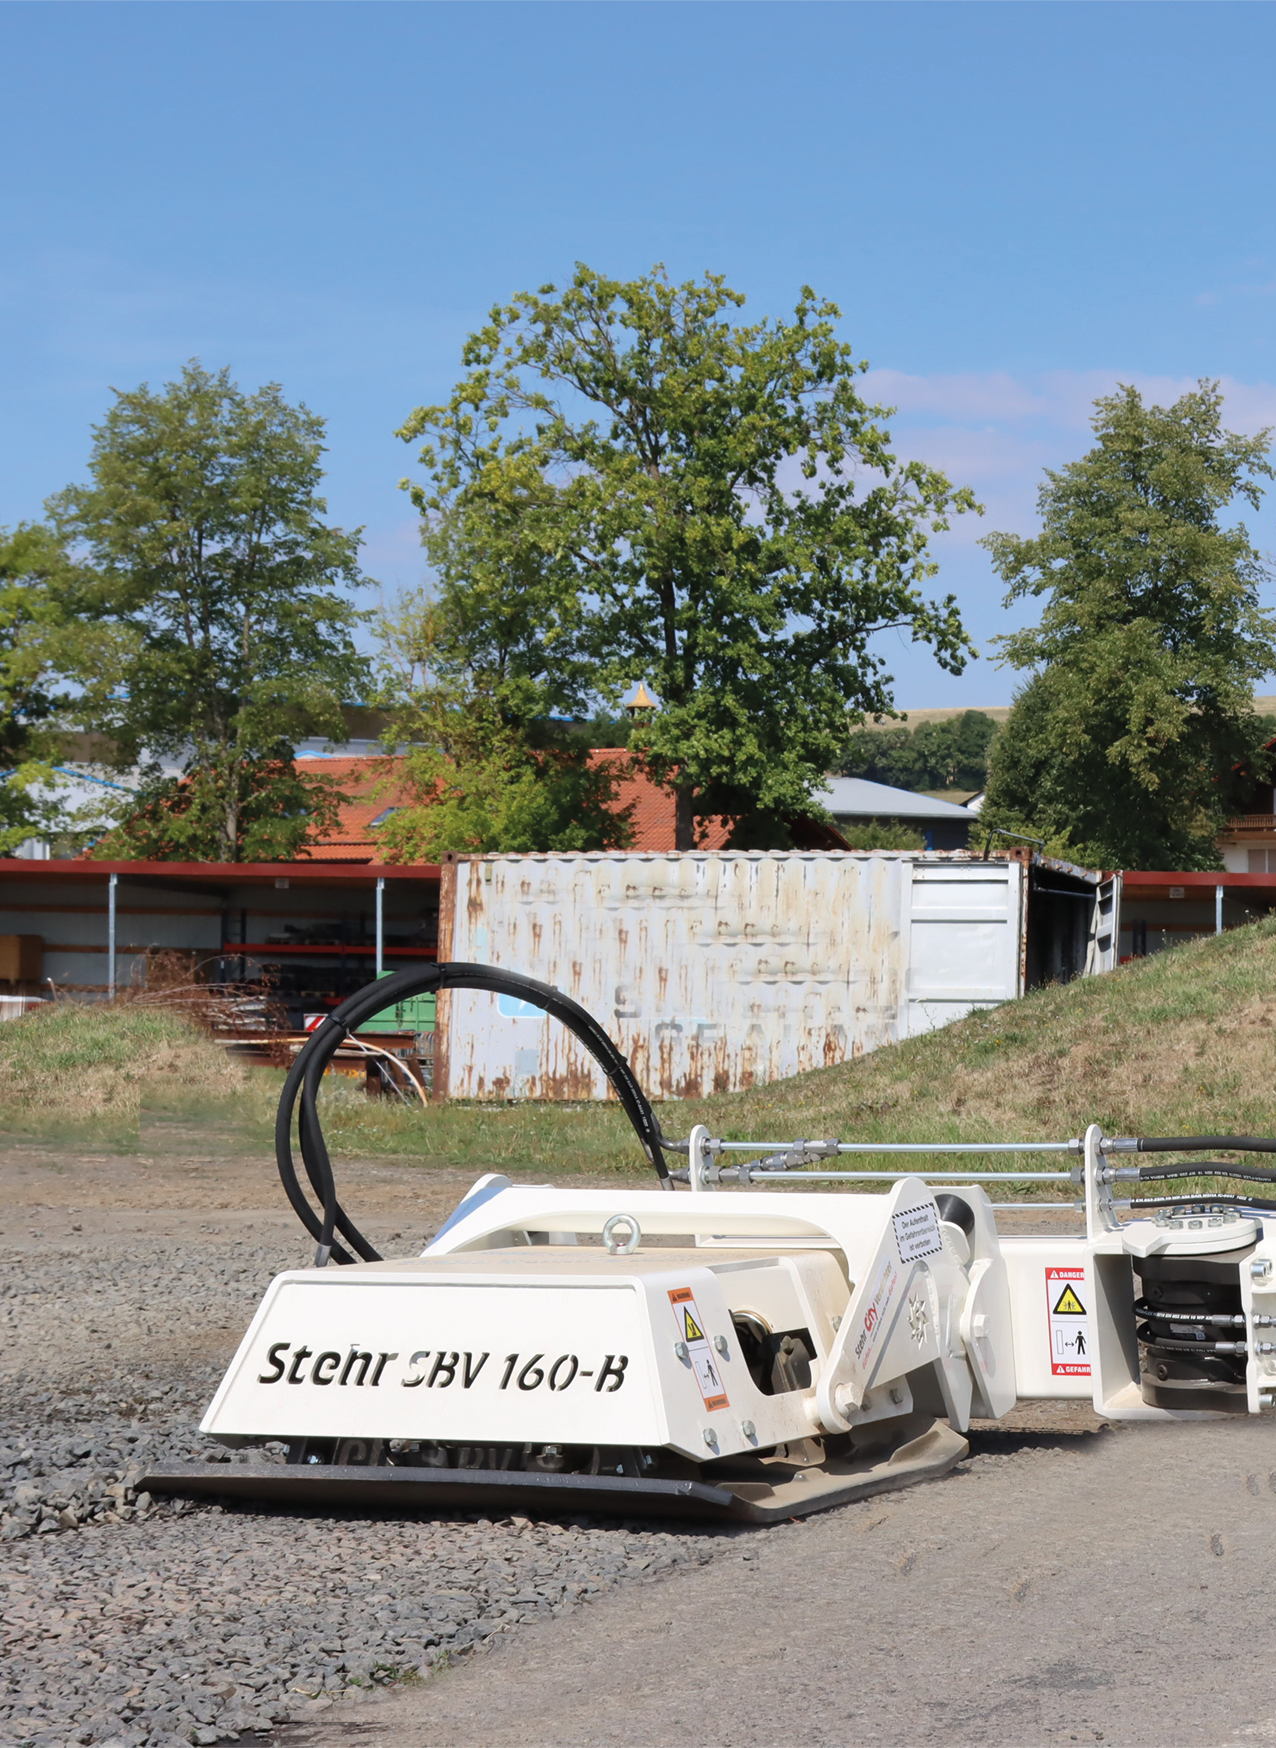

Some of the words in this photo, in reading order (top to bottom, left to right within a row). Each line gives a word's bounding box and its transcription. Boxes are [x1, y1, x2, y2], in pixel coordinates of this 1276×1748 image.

[258, 1342, 399, 1387] Stehr
[401, 1350, 491, 1389] SBV
[498, 1353, 629, 1393] 160-B
